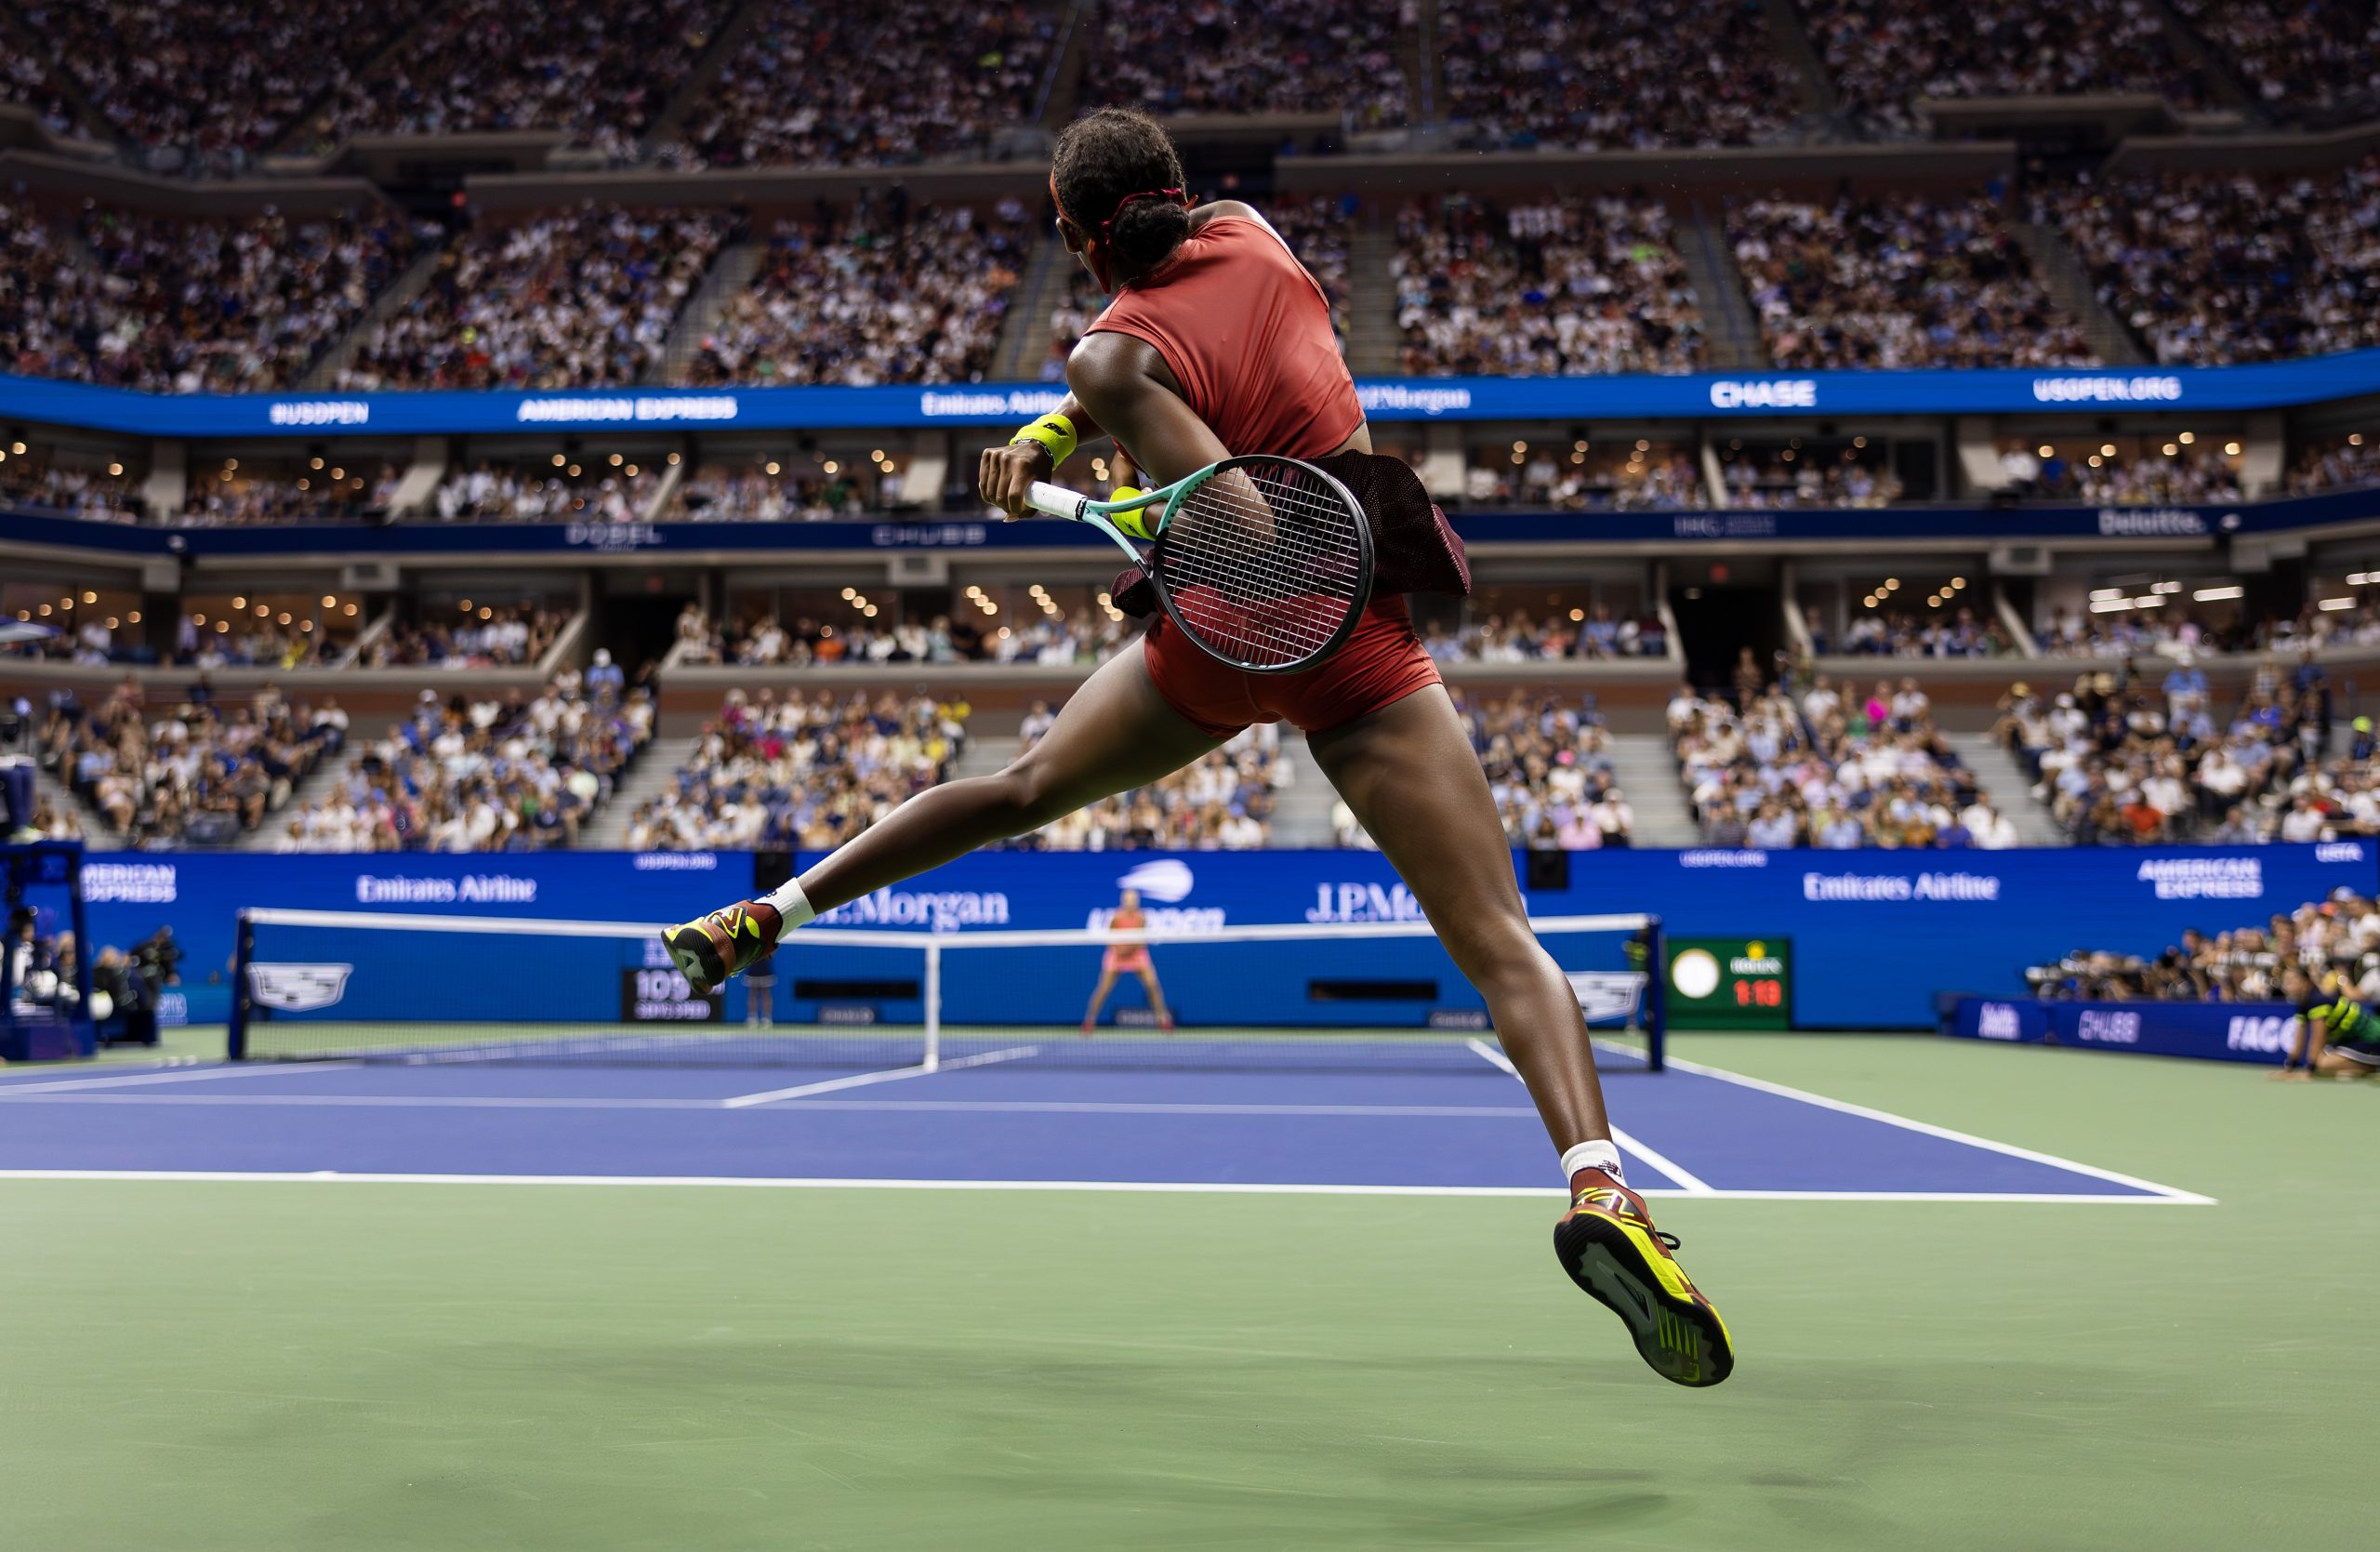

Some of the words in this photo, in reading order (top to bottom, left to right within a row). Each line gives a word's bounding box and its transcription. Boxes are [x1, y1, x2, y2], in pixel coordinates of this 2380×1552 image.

[1711, 380, 1817, 408] CHASE
[2033, 376, 2182, 402] USOPEN.ORG
[517, 398, 634, 421] AMERICAN
[635, 396, 737, 420] EXPRESS
[921, 391, 1007, 416] Emirates
[81, 863, 176, 882] MERICAN
[2137, 858, 2261, 882] AMERICAN
[357, 874, 456, 903] Emirates
[456, 874, 537, 903] Airline
[1804, 872, 1911, 901] Emirates
[1912, 872, 2001, 901] Airline
[2155, 879, 2264, 899] EXPRESS
